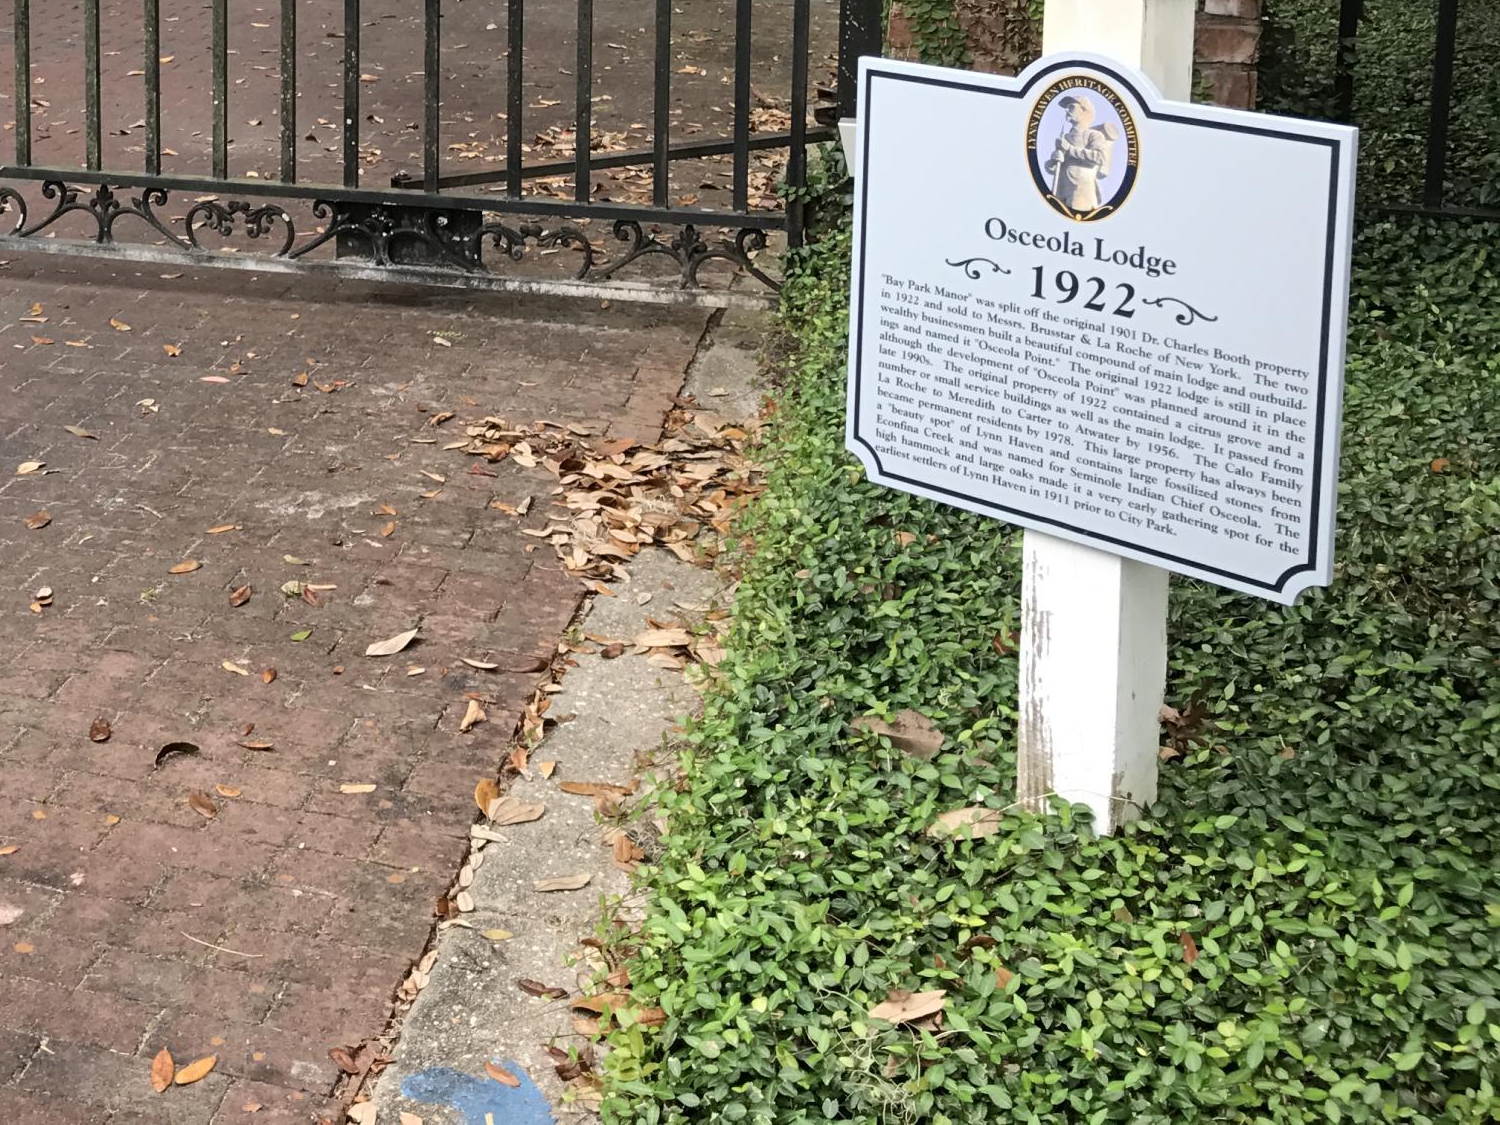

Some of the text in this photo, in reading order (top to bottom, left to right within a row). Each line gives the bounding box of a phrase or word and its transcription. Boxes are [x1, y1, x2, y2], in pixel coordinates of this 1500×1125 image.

[1027, 77, 1138, 166] LYNN HAVEN HERITAGE COMMITTEE
[984, 217, 1177, 278] Osceola Lodge
[1030, 265, 1136, 319] 1922
[879, 316, 1307, 428] ings and named "Osceola Point." The original 1922 lodge still place
[880, 304, 1307, 410] wealthy businessmen built beautiful compound main lodge and outbuild-
[881, 273, 1310, 381] "Bay Park Manor" was split off the original 1901 Dr. Charles Booth property
[896, 291, 1309, 395] 1922 and sold Messrs. Brusstar La Roche New York. The two
[877, 371, 1303, 493] La Roche Meredith Carter Atwater 1956. The Calo Family
[878, 343, 1291, 456] late 1990s. The original property 1922 contained citrus grove and
[878, 360, 1304, 476] number small service buildings well the main lodge. passed from
[879, 330, 1306, 444] although the development "Osceola Point" was planned around the
[875, 444, 1177, 536] earliest settlers Lynn Haven 1911 prior City Park.
[875, 427, 1300, 555] high hammock and large oaks made very early gathering spot for the
[876, 413, 1300, 540] Econfina Creek and was named for Seminole Indian Chief Osceola. The
[877, 385, 1302, 508] became permanent residents 1978. This large property has always been
[888, 402, 1301, 524] "beauty spot" Lynn Haven and contains large fossilized stones from
